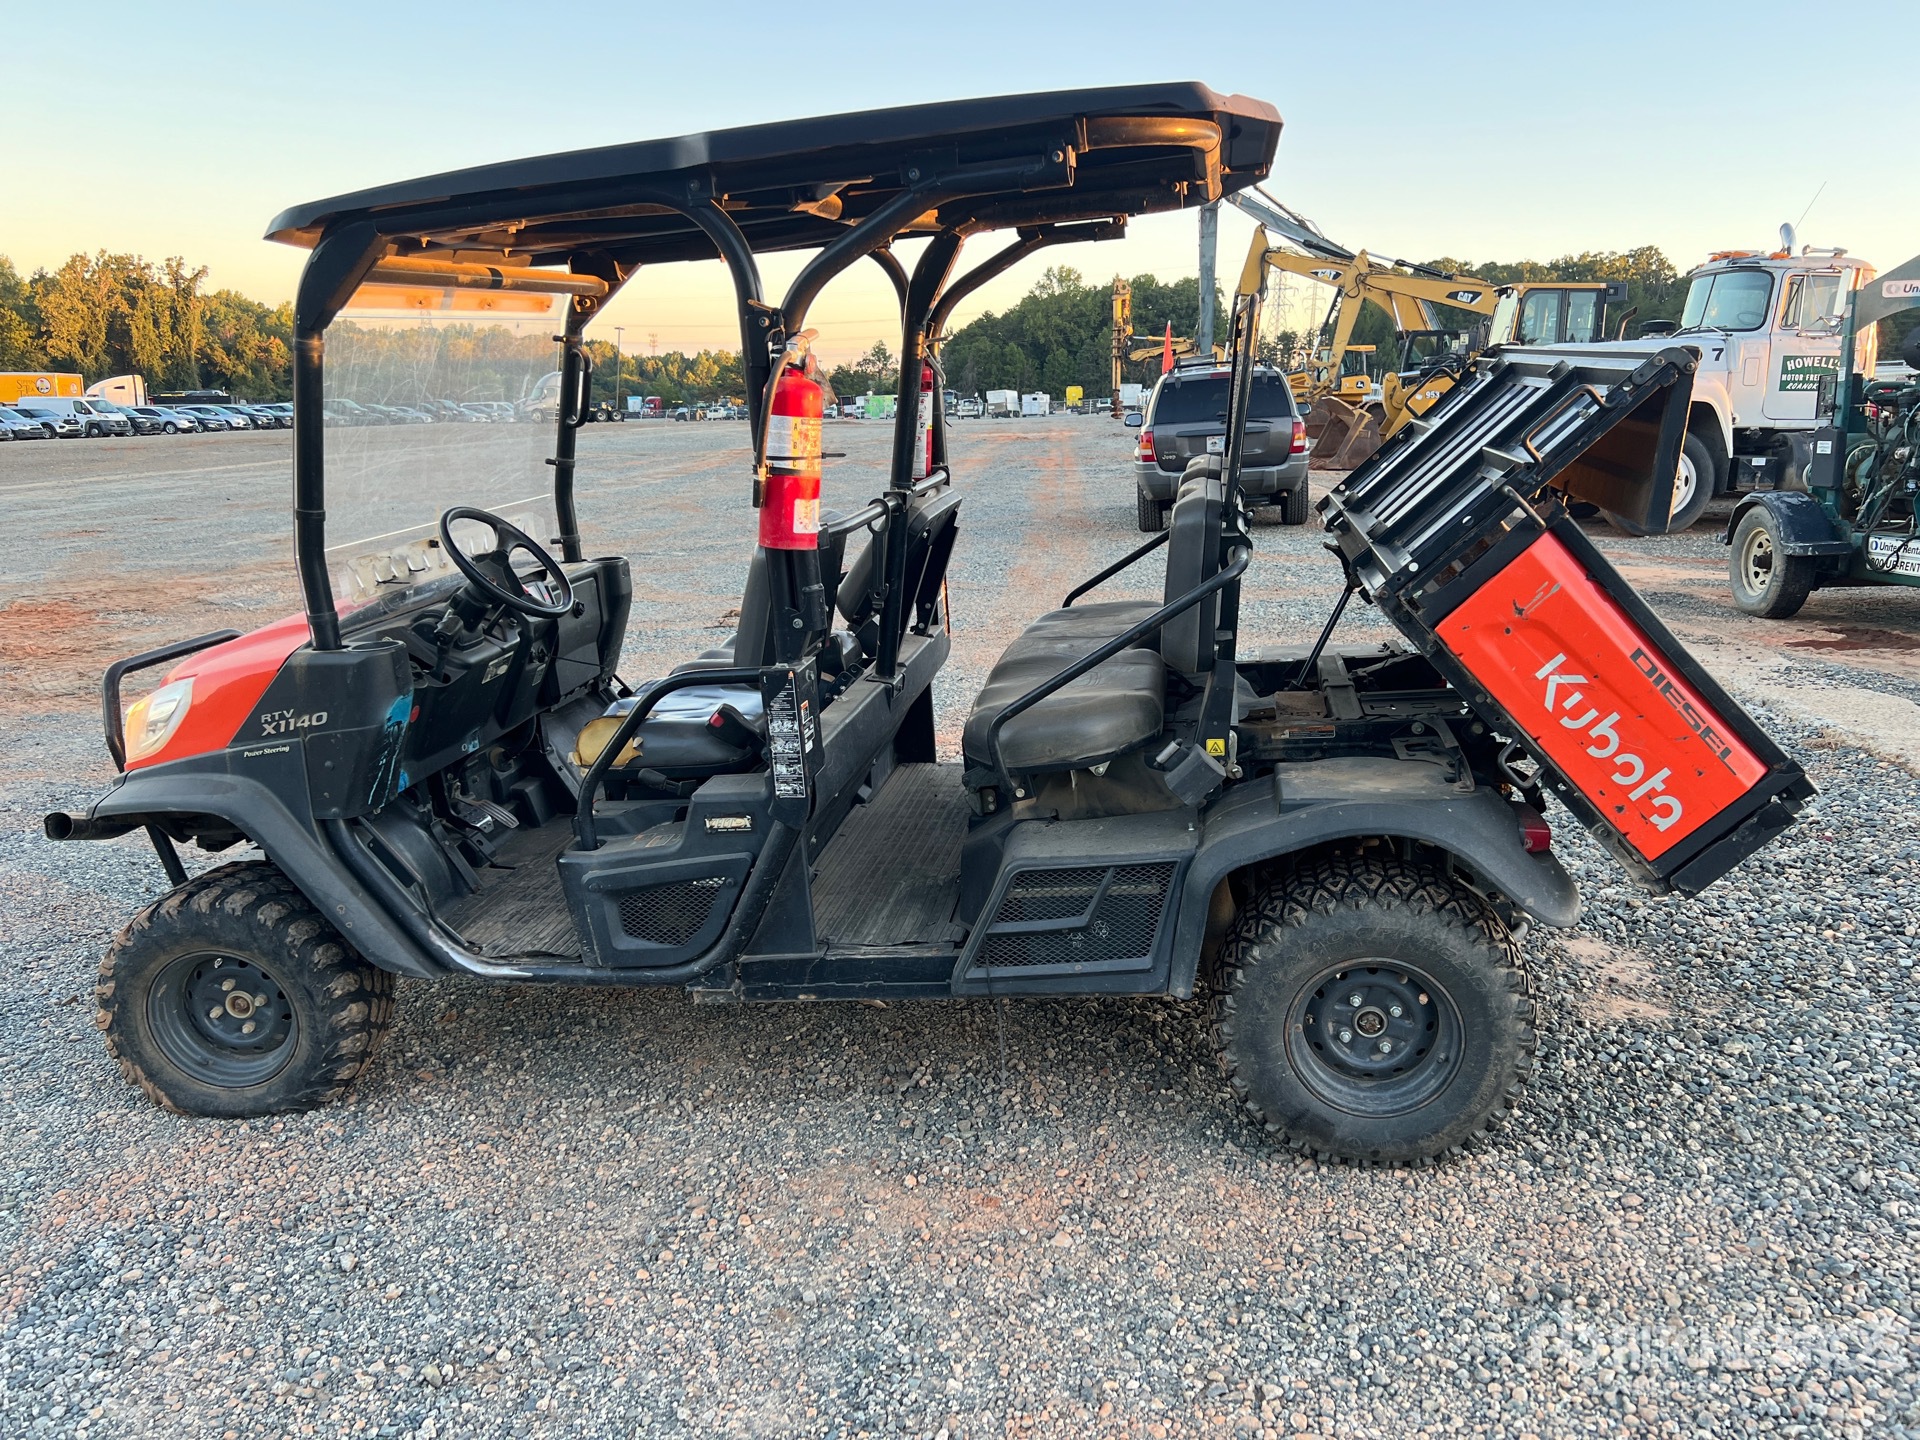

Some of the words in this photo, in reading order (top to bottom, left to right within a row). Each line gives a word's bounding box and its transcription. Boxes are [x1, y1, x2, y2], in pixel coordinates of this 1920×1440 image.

[1903, 283, 1920, 293] Un
[1457, 291, 1473, 303] CAT
[1712, 347, 1724, 361] 7
[1786, 382, 1819, 390] ROANOK
[261, 708, 294, 723] RTV
[1629, 647, 1737, 777] DIESEL
[261, 711, 328, 737] X1140
[1534, 652, 1683, 833] Kubota
[243, 749, 263, 758] Power
[263, 745, 290, 755] Steering
